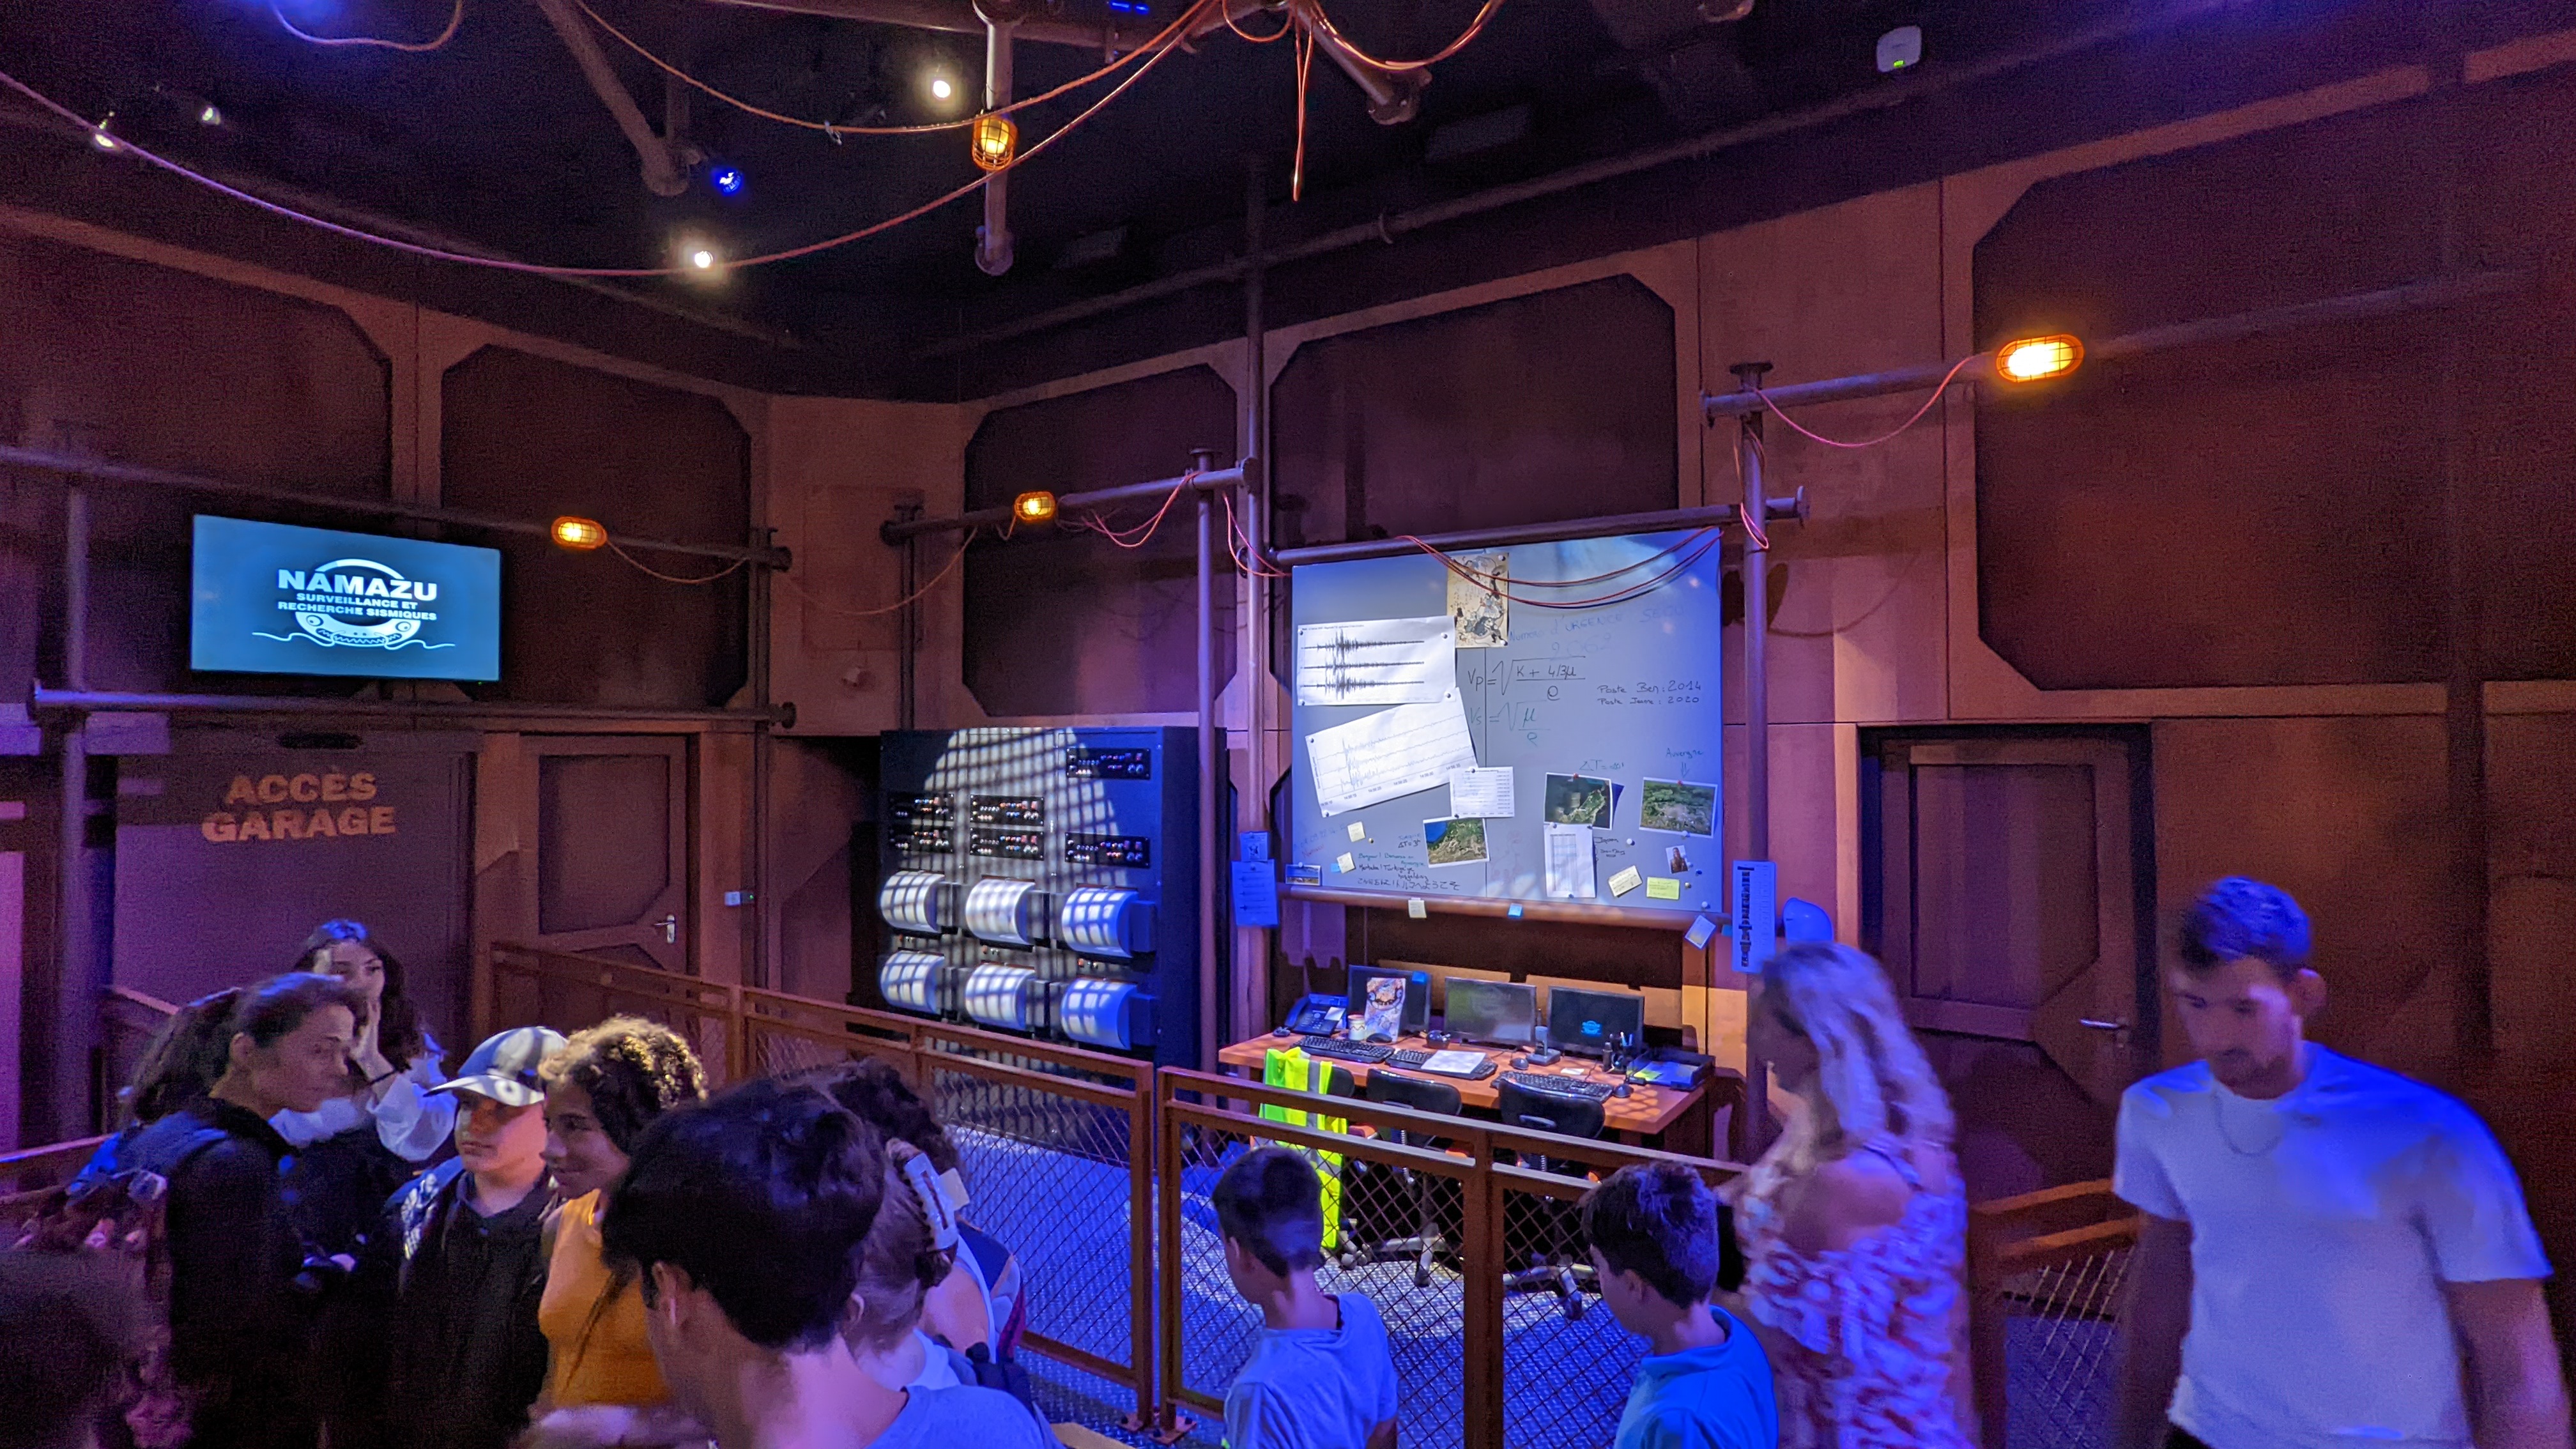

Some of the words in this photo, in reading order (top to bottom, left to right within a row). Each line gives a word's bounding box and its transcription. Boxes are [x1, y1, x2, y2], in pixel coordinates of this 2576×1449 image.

[279, 569, 437, 601] NAMAZU
[278, 601, 363, 615] RECHERCHE
[366, 608, 437, 620] SISMIQUES
[296, 593, 399, 608] SURVEILLANCE
[402, 601, 418, 610] ET
[1597, 685, 1627, 694] Poste
[1667, 680, 1701, 692] 2014
[1666, 747, 1704, 759] Auvergne
[202, 806, 397, 843] GARAGE
